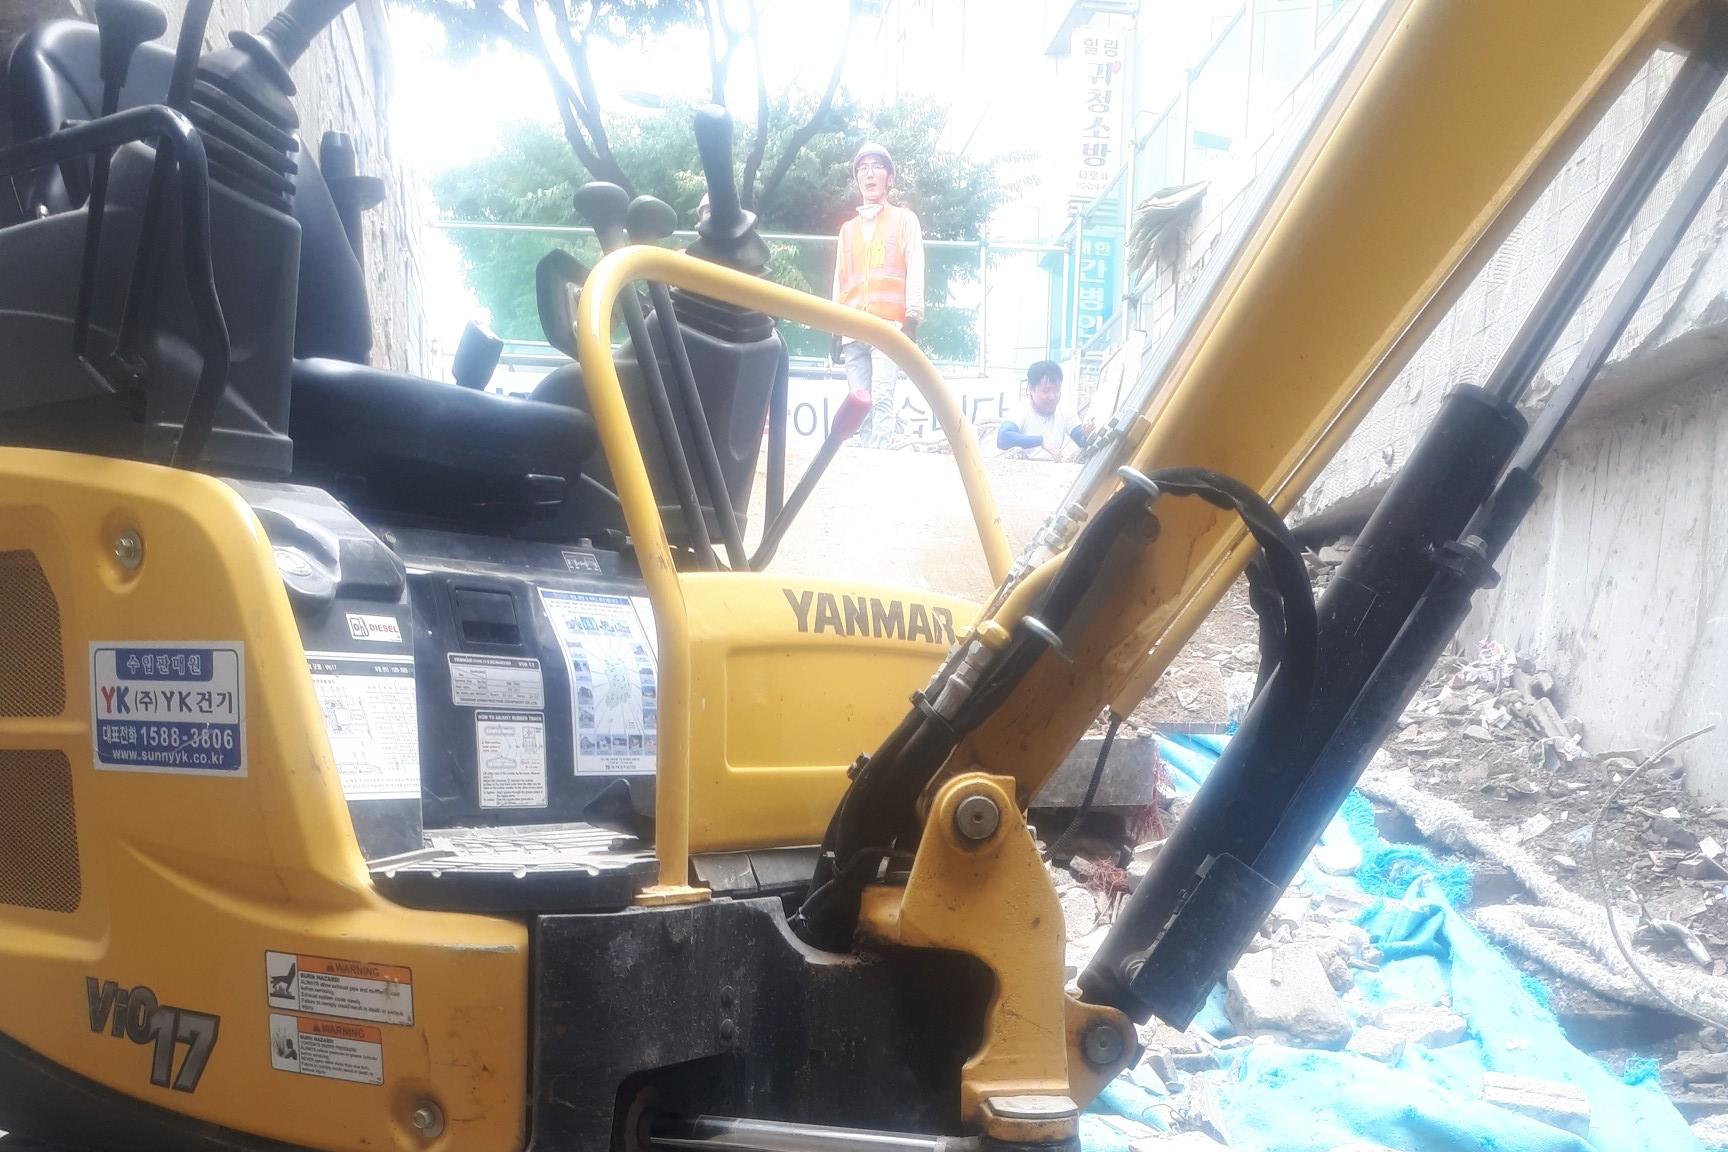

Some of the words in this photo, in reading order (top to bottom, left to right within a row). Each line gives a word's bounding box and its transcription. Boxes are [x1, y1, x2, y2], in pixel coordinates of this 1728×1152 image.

[1084, 37, 1118, 58] 힐링
[783, 588, 957, 646] YANMAR
[369, 623, 399, 633] DIESEL
[127, 654, 202, 676] 수입판매원
[101, 686, 131, 714] YK
[102, 725, 137, 745] 대표전화
[140, 726, 233, 749] 1588-3806
[112, 749, 224, 765] www.sunnyyk.co.kr
[335, 962, 379, 977] WARNING
[321, 1023, 365, 1038] WARNING
